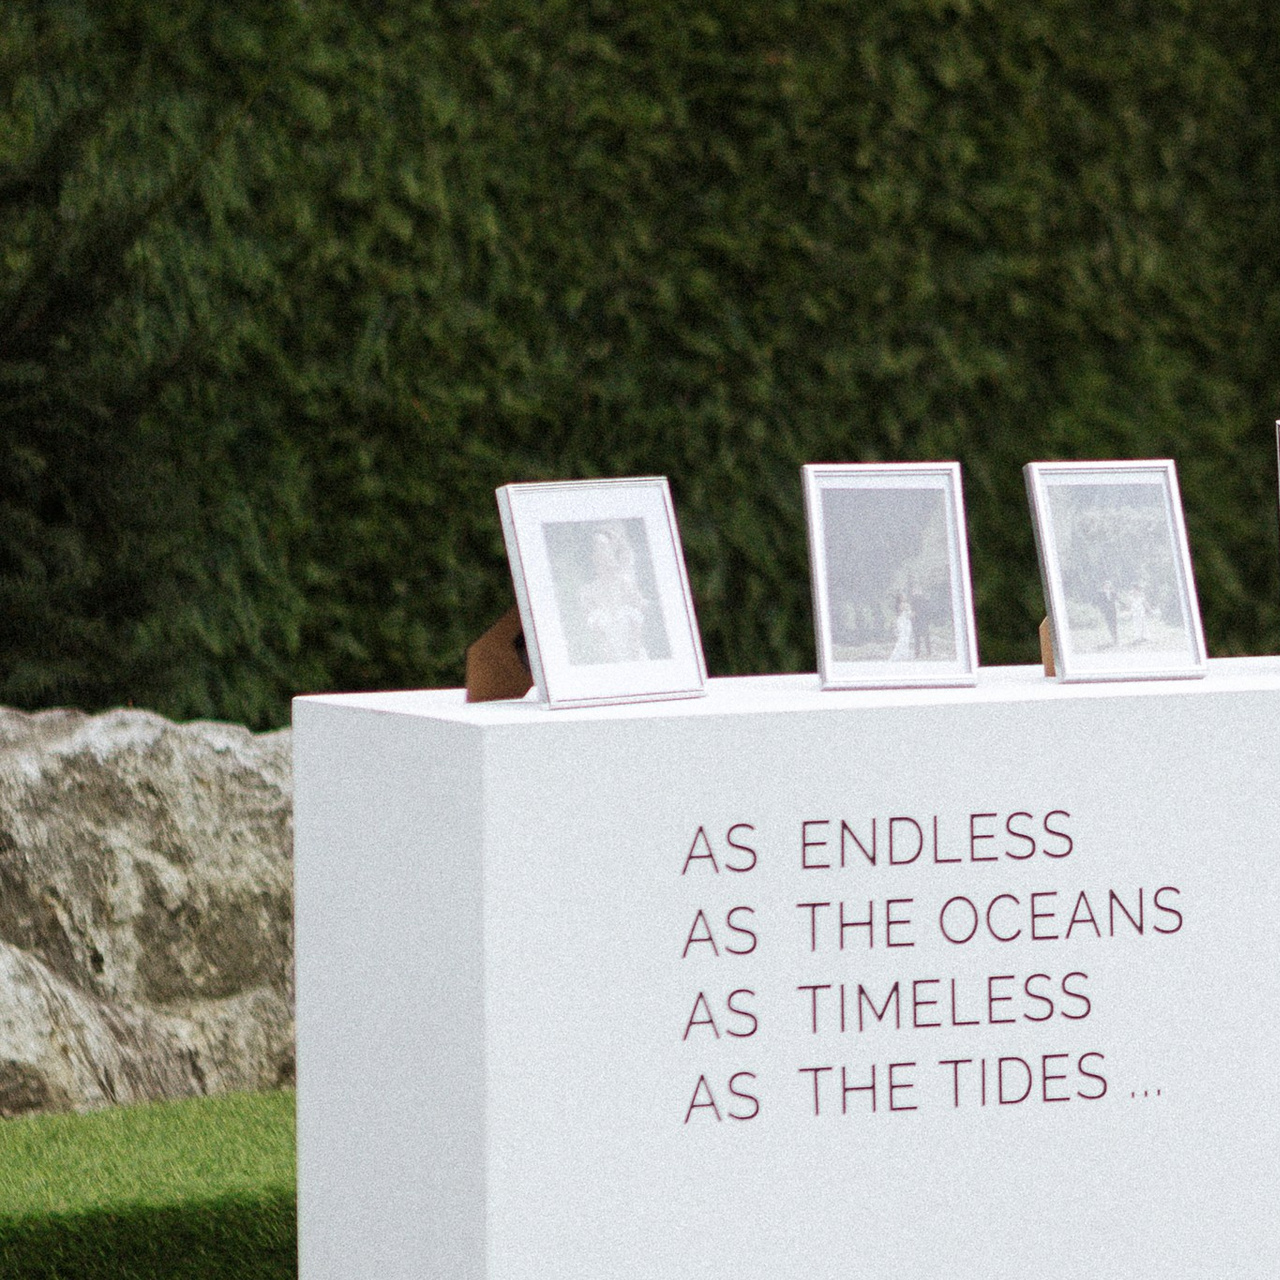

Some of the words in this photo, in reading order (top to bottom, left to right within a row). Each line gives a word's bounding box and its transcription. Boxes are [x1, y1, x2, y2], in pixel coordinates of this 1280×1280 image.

[682, 824, 758, 875] AS
[801, 810, 1074, 870] ENDLESS
[682, 906, 758, 959] AS
[797, 898, 915, 952] THE
[939, 886, 1184, 945] OCEANS
[683, 989, 759, 1041] AS
[798, 972, 1092, 1034] TIMELESS
[684, 1071, 760, 1124] AS
[799, 1062, 918, 1116] THE
